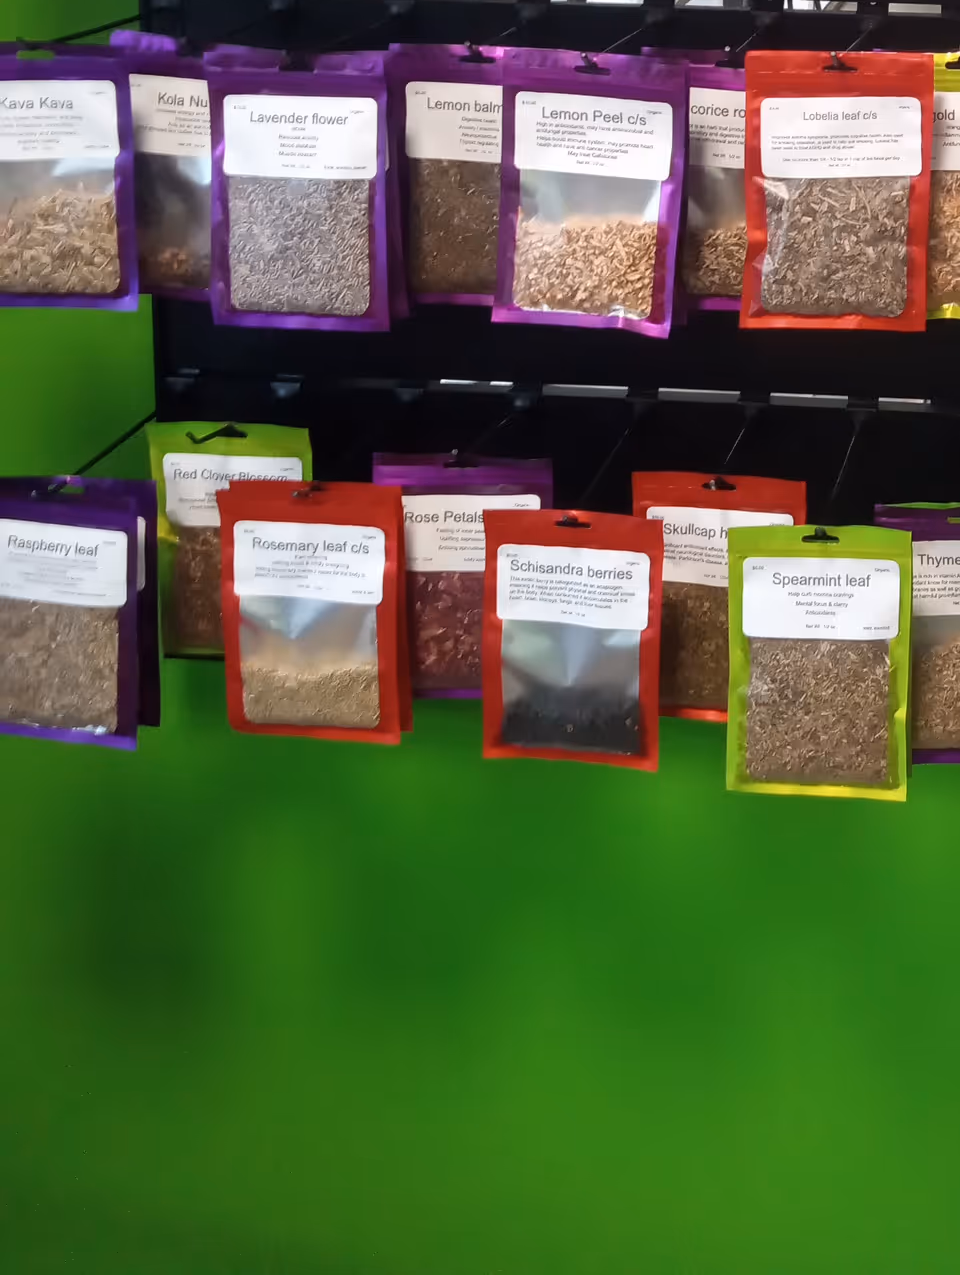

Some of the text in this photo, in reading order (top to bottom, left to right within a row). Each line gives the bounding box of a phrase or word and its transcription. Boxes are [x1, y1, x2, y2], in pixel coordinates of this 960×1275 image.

[0, 97, 74, 110] Kava Kava
[157, 92, 185, 107] Kola
[427, 97, 504, 114] Lemon balm
[250, 111, 349, 126] Lavender flower
[541, 106, 647, 126] Lemon Peel c/s
[803, 110, 878, 121] Lobelia leaf c/s
[173, 468, 197, 480] Red
[201, 468, 236, 482] Clover
[404, 510, 484, 524] Rose Petals
[663, 523, 716, 540] Skullcap
[7, 535, 100, 557] Raspberry leaf
[252, 536, 370, 556] Rosemary leaf c/s
[510, 559, 633, 580] Schisandra berries
[772, 572, 872, 588] Spearmint leaf
